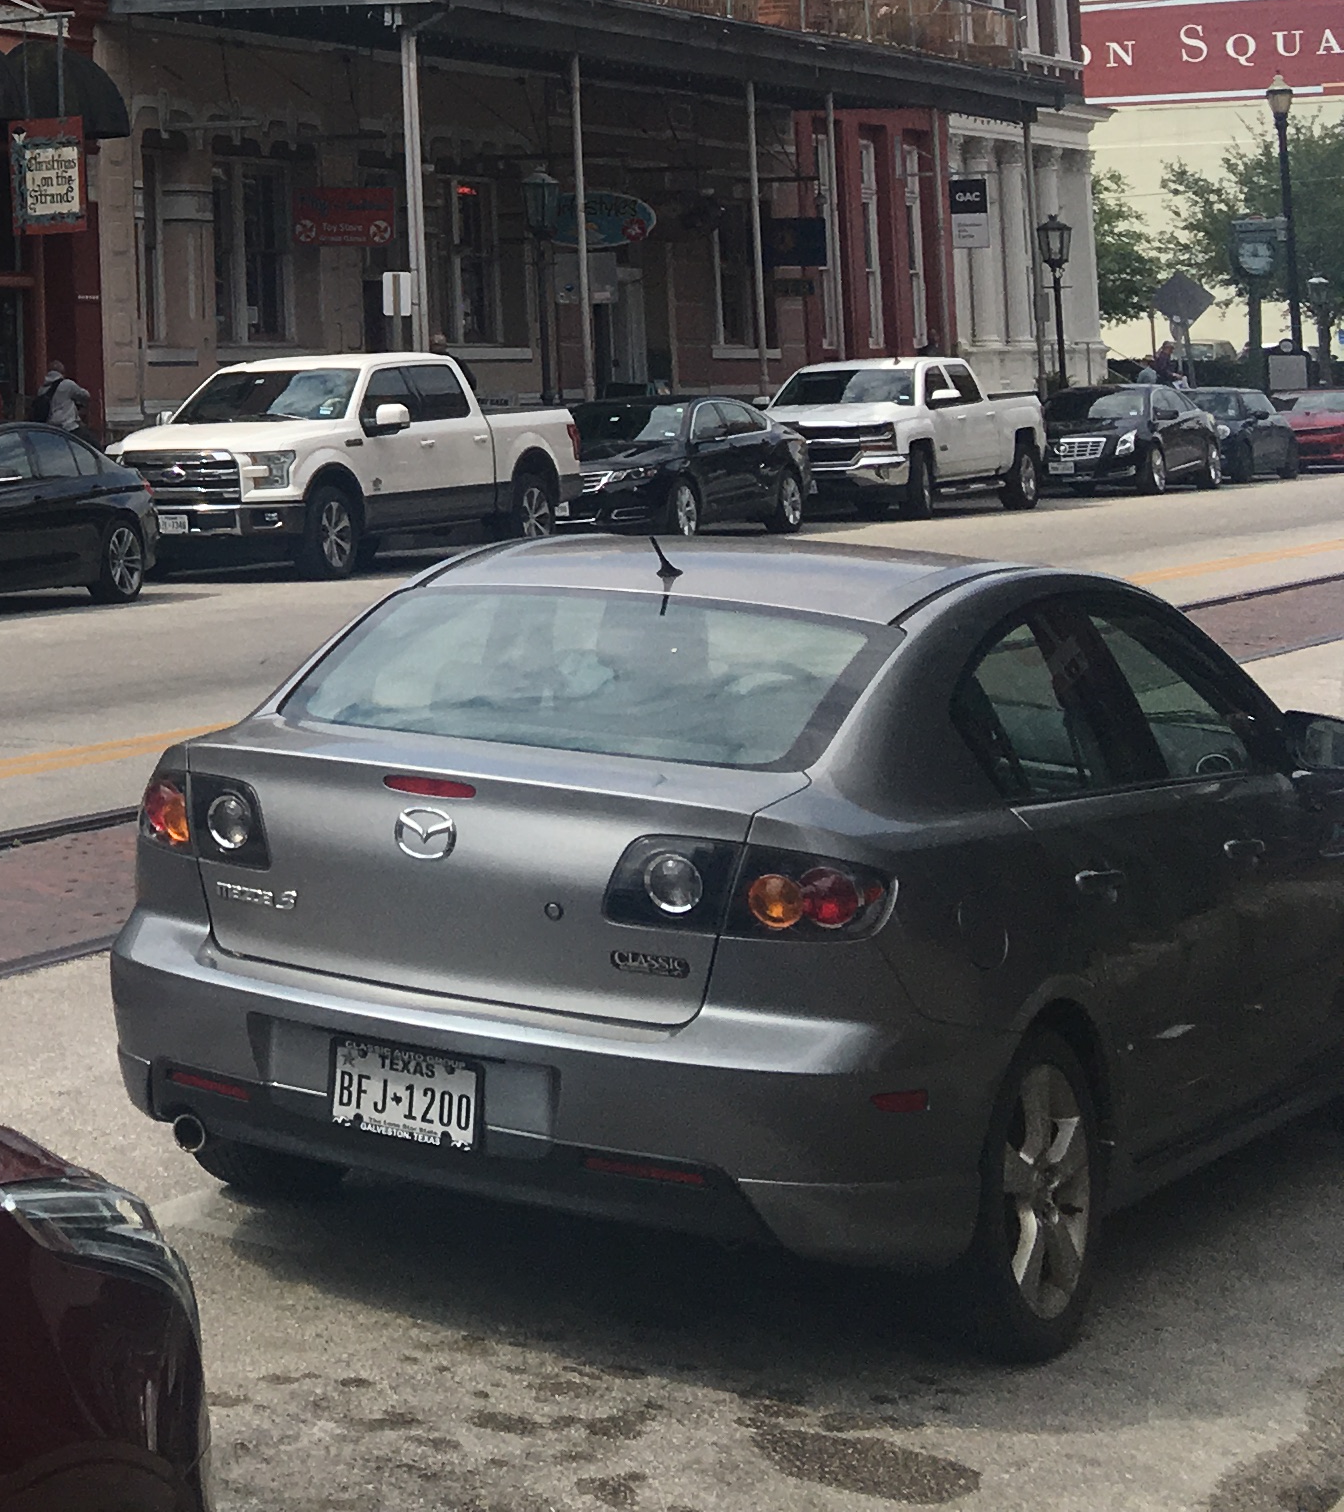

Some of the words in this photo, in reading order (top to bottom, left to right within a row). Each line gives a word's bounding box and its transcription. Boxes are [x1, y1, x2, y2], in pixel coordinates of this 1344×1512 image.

[26, 153, 77, 172] Christmas
[40, 176, 54, 187] on
[56, 170, 76, 186] the
[28, 185, 75, 206] Strand
[955, 191, 981, 202] GAC
[322, 222, 337, 233] Toy
[614, 951, 683, 971] CLASSIC
[394, 1049, 424, 1063] AUTO
[378, 1054, 436, 1079] TEXAS
